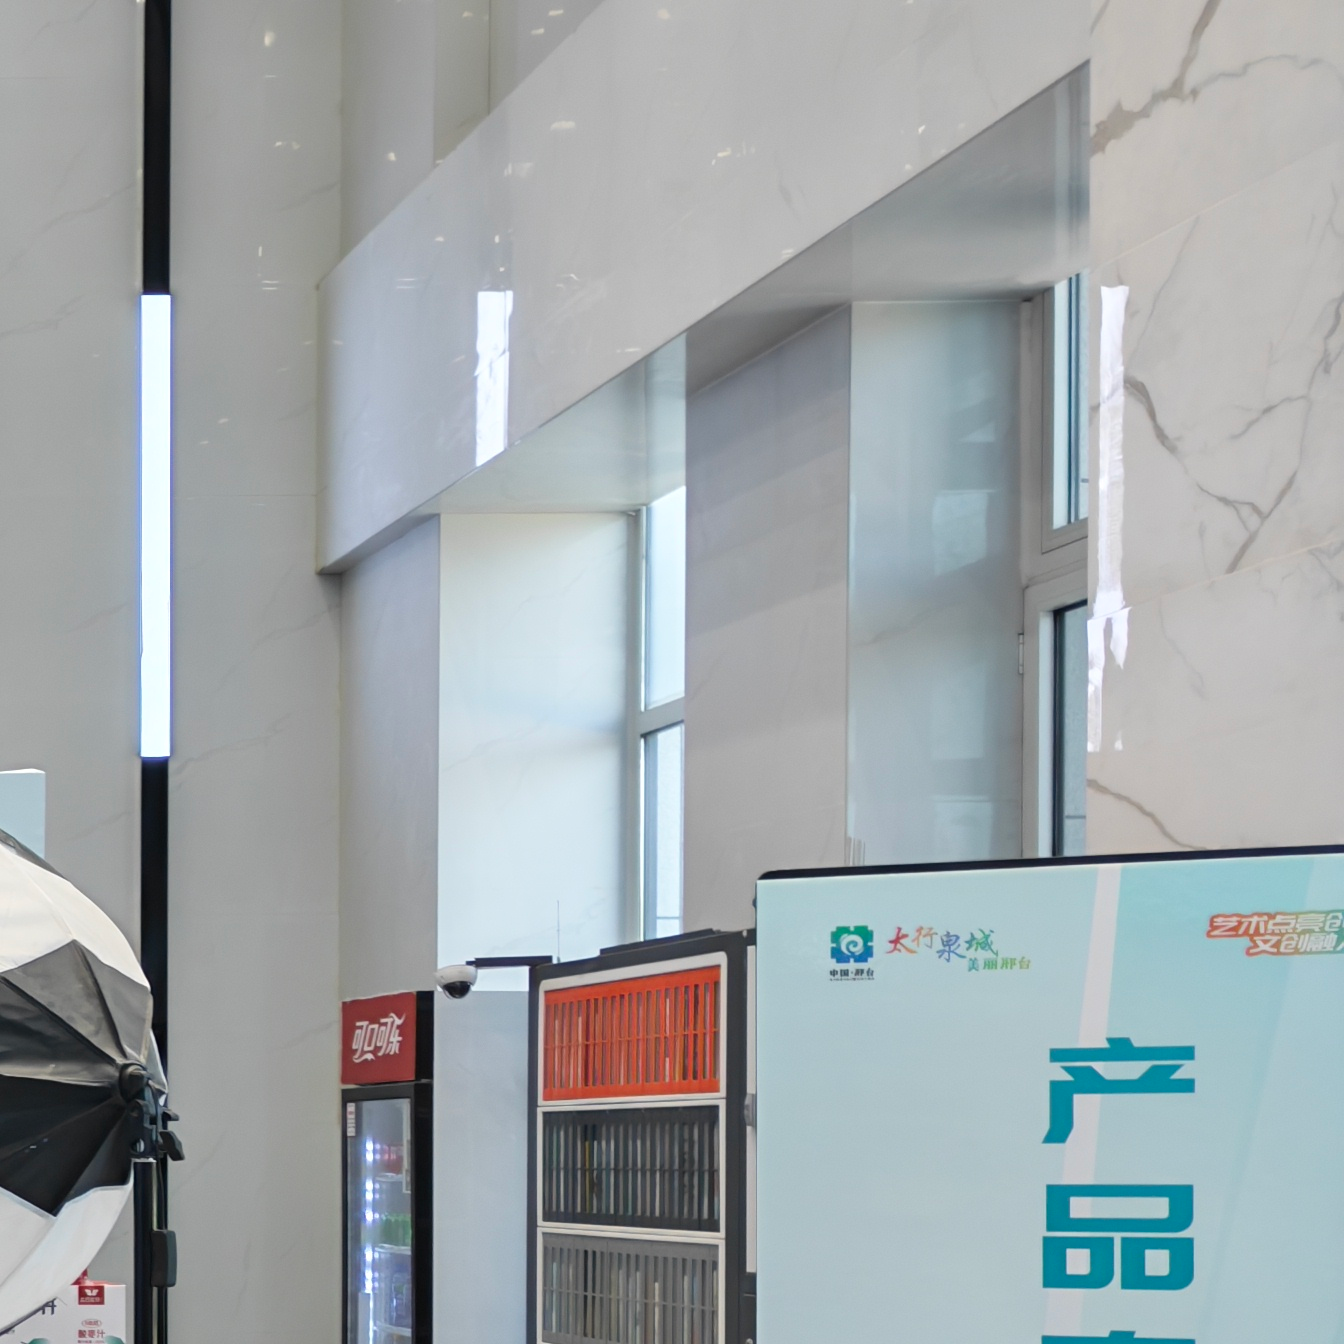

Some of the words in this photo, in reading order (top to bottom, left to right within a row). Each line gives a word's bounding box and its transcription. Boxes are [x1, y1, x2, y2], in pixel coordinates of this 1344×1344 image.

[886, 926, 999, 963] 太行泉城
[1249, 932, 1344, 953] 文创融
[352, 1012, 406, 1063] 可口可乐
